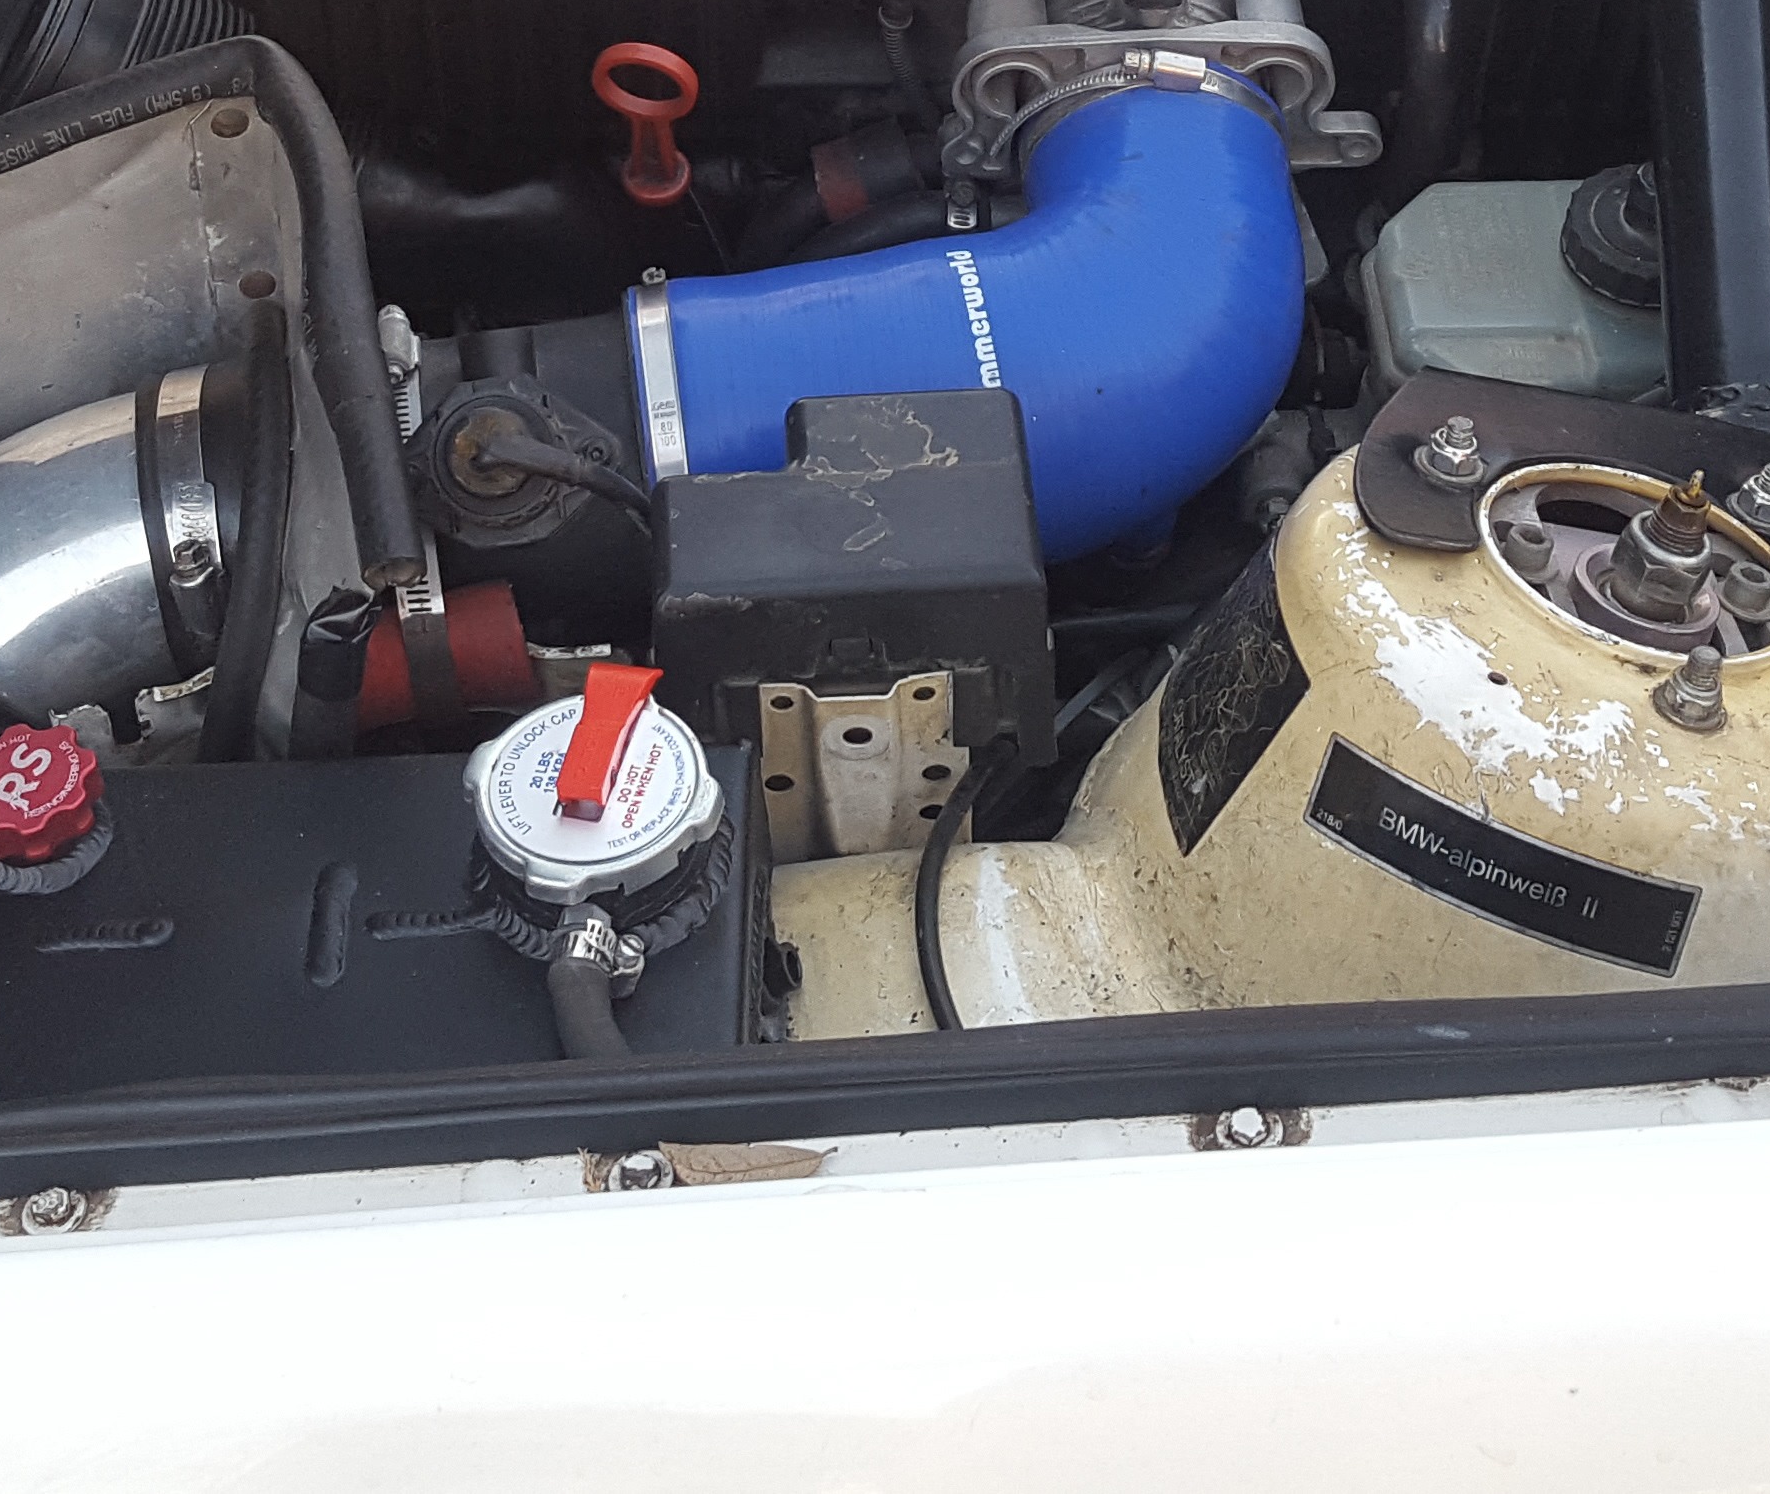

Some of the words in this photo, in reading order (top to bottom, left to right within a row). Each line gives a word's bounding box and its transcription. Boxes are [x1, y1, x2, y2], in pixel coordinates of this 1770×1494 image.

[89, 101, 135, 131] FUEL
[41, 119, 86, 150] LINE
[945, 249, 1001, 388] mmerworld
[550, 708, 577, 726] CAP
[9, 733, 31, 745] HOT
[510, 720, 550, 760] UNLOCK
[536, 751, 553, 775] LBS
[499, 777, 515, 812] LEVER
[529, 776, 544, 789] 20
[616, 788, 629, 803] DO
[623, 764, 641, 787] NOT
[621, 799, 640, 829] OPEN
[634, 766, 654, 799] WHEN
[647, 743, 663, 766] HOT
[506, 812, 532, 836] LIFT
[607, 838, 627, 849] TEST
[629, 830, 642, 841] OR
[641, 806, 672, 837] REPLACE
[1376, 808, 1569, 909] BMW-alpinweiß
[1580, 894, 1600, 919] II
